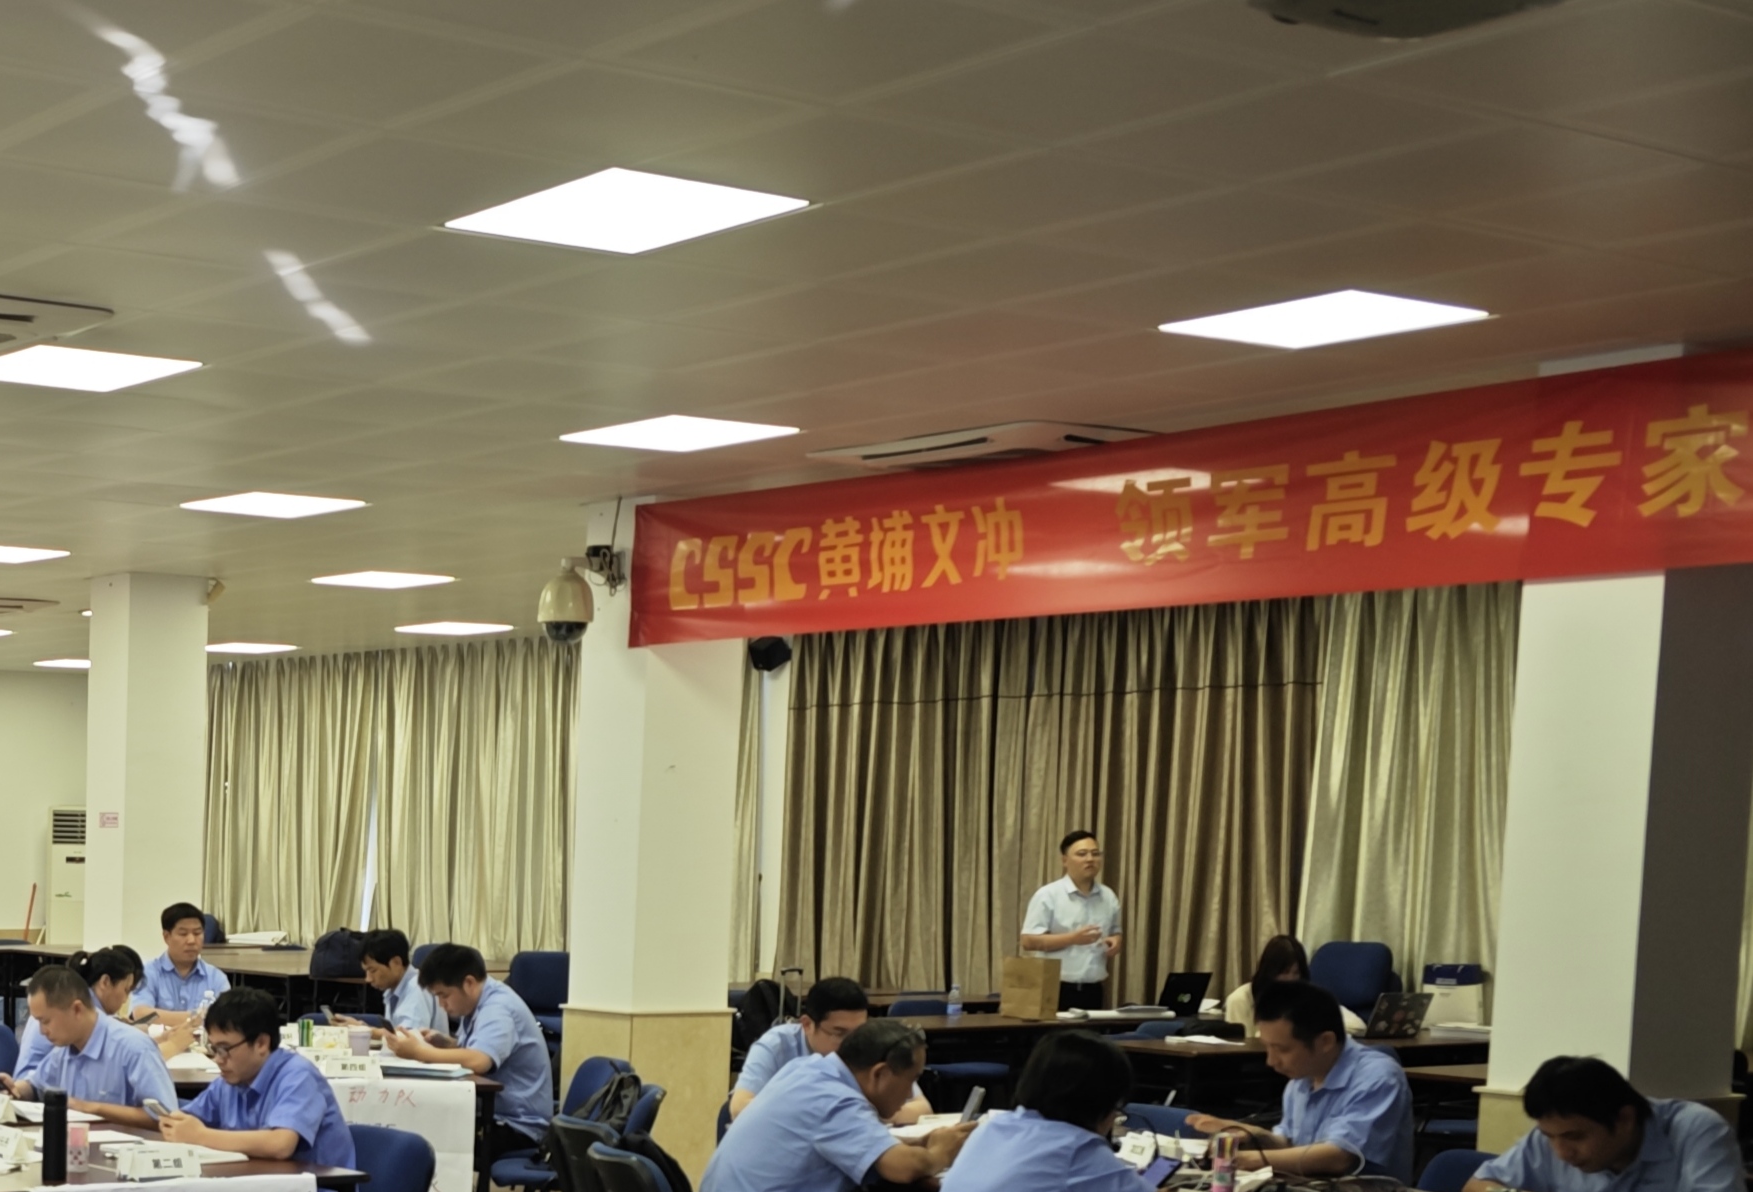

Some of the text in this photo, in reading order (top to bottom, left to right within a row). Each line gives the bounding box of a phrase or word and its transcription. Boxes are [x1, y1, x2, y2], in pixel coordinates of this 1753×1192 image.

[1120, 404, 1749, 566] 领军高级专家
[341, 1063, 366, 1072] 第四组
[348, 1087, 416, 1108] 动力队
[152, 1158, 183, 1169] 第二组
